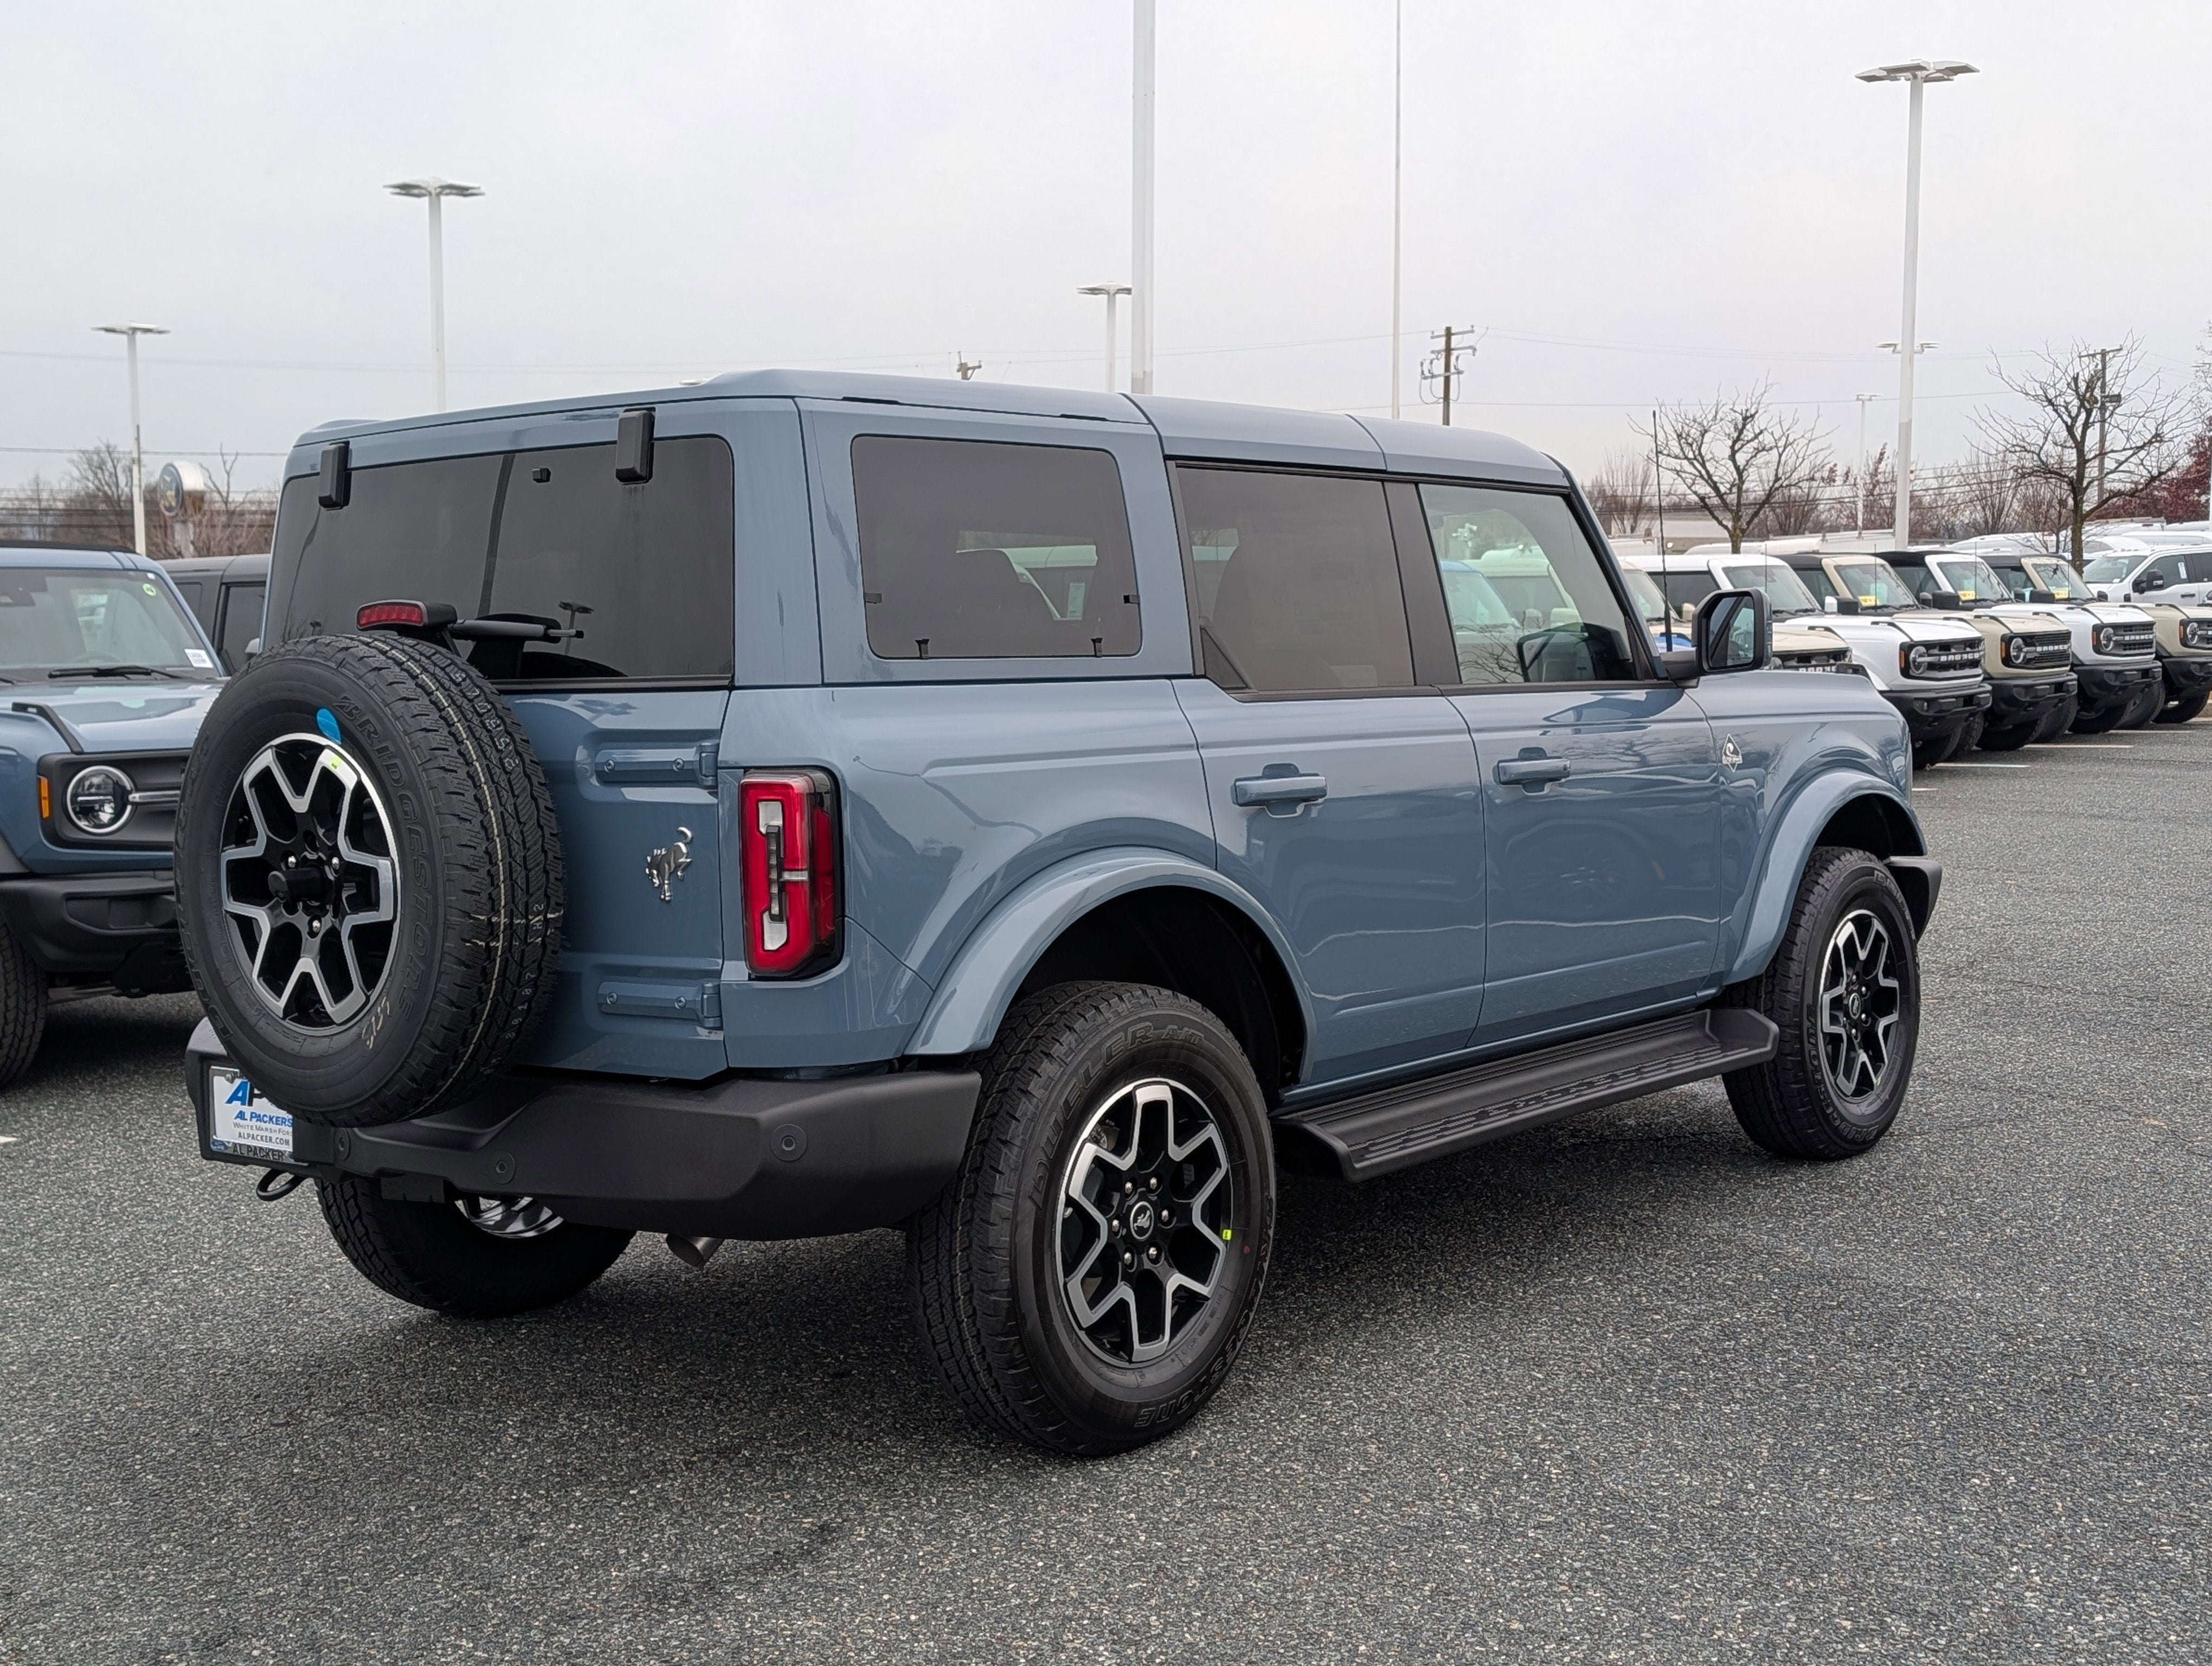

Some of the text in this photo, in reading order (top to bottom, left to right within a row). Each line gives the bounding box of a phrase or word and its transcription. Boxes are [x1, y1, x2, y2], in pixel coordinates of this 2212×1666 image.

[332, 694, 433, 1022] BRIDGESTONE
[234, 1110, 248, 1120] AL
[1028, 1021, 1206, 1209] DUELER A/T
[237, 1131, 290, 1146] ALPACKER.COM
[233, 1143, 245, 1155] AL
[247, 1145, 284, 1162] PACKER
